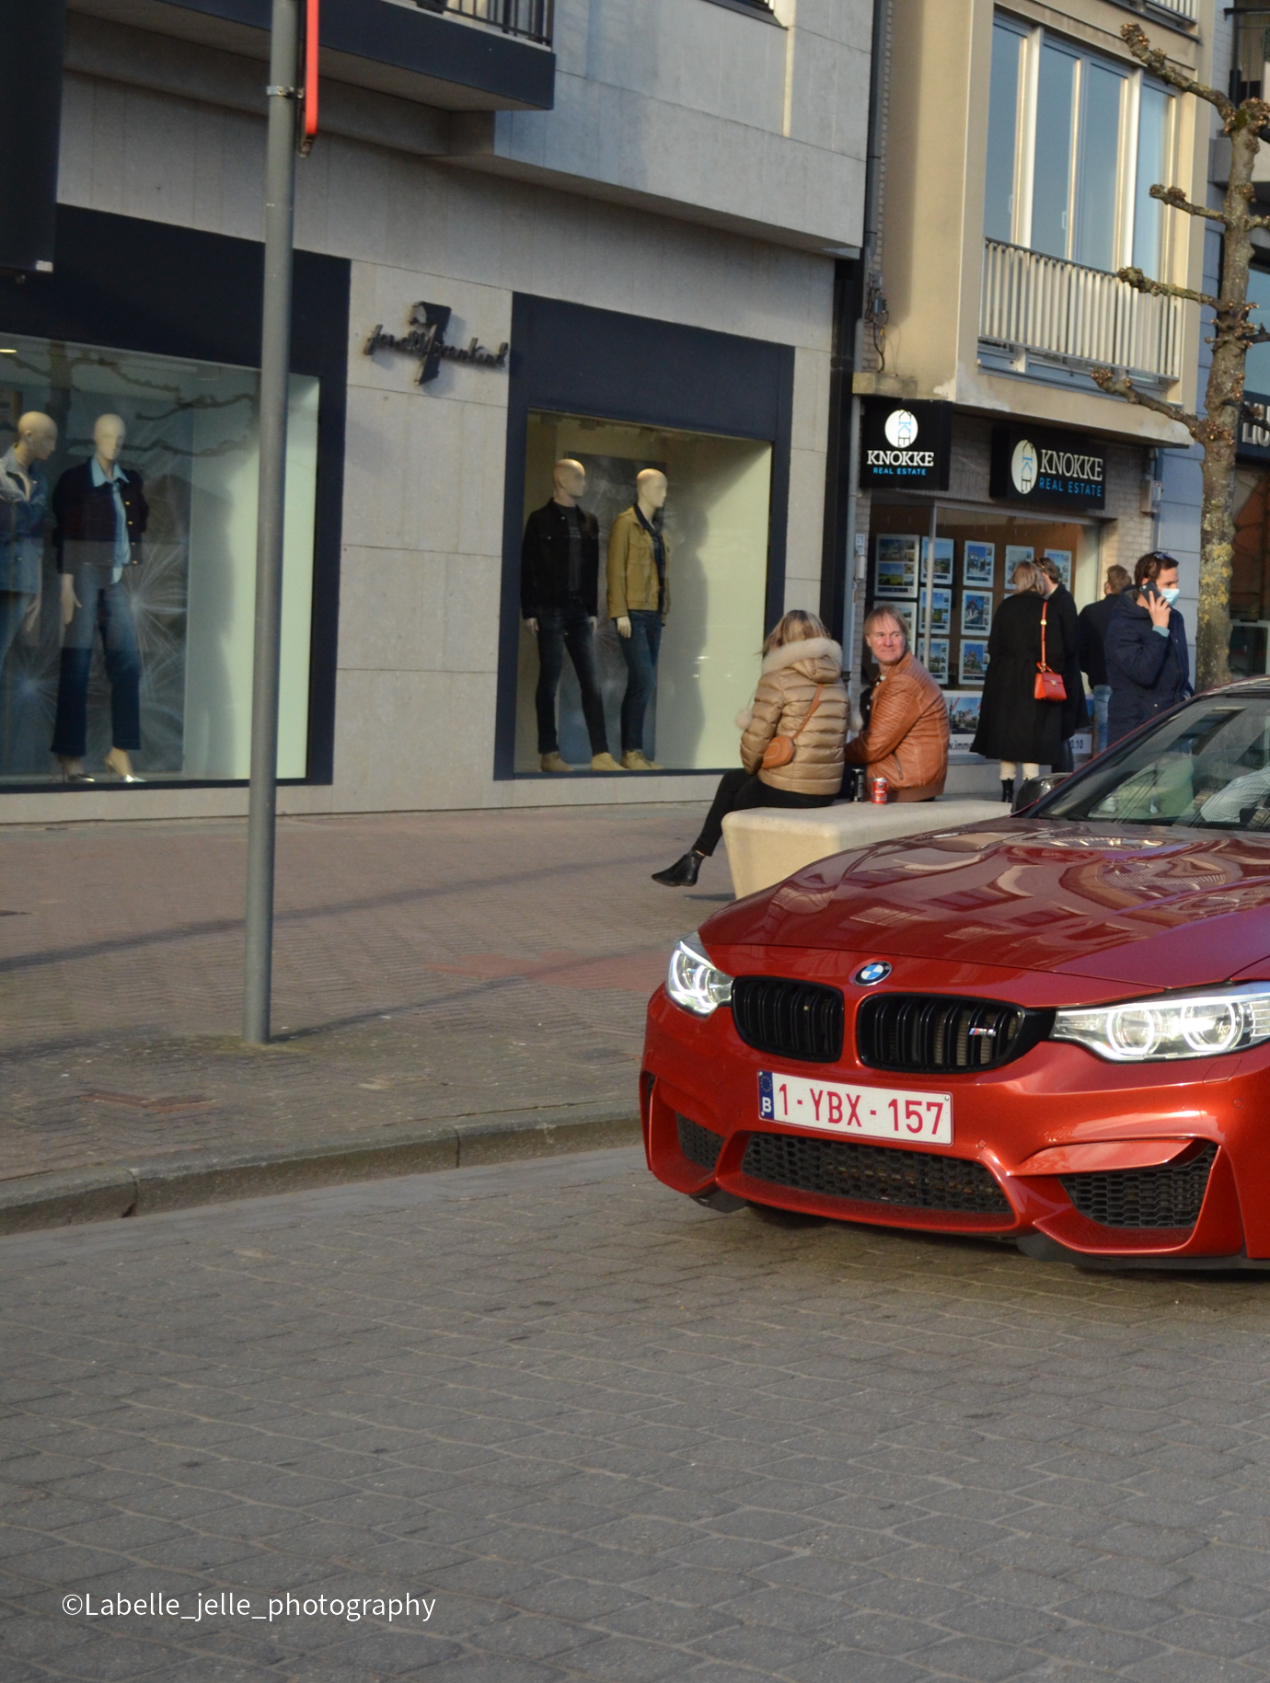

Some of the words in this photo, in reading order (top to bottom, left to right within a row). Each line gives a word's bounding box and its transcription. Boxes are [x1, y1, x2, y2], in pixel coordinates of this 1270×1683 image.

[866, 450, 935, 467] KNOKKE
[1039, 449, 1104, 481] KNOKKE
[873, 467, 894, 475] REAL
[897, 468, 927, 476] ESTATE
[1039, 477, 1064, 492] REAL
[1067, 480, 1102, 497] ESTATE
[762, 1097, 772, 1113] B
[778, 1083, 944, 1135] 1-YBX-157
